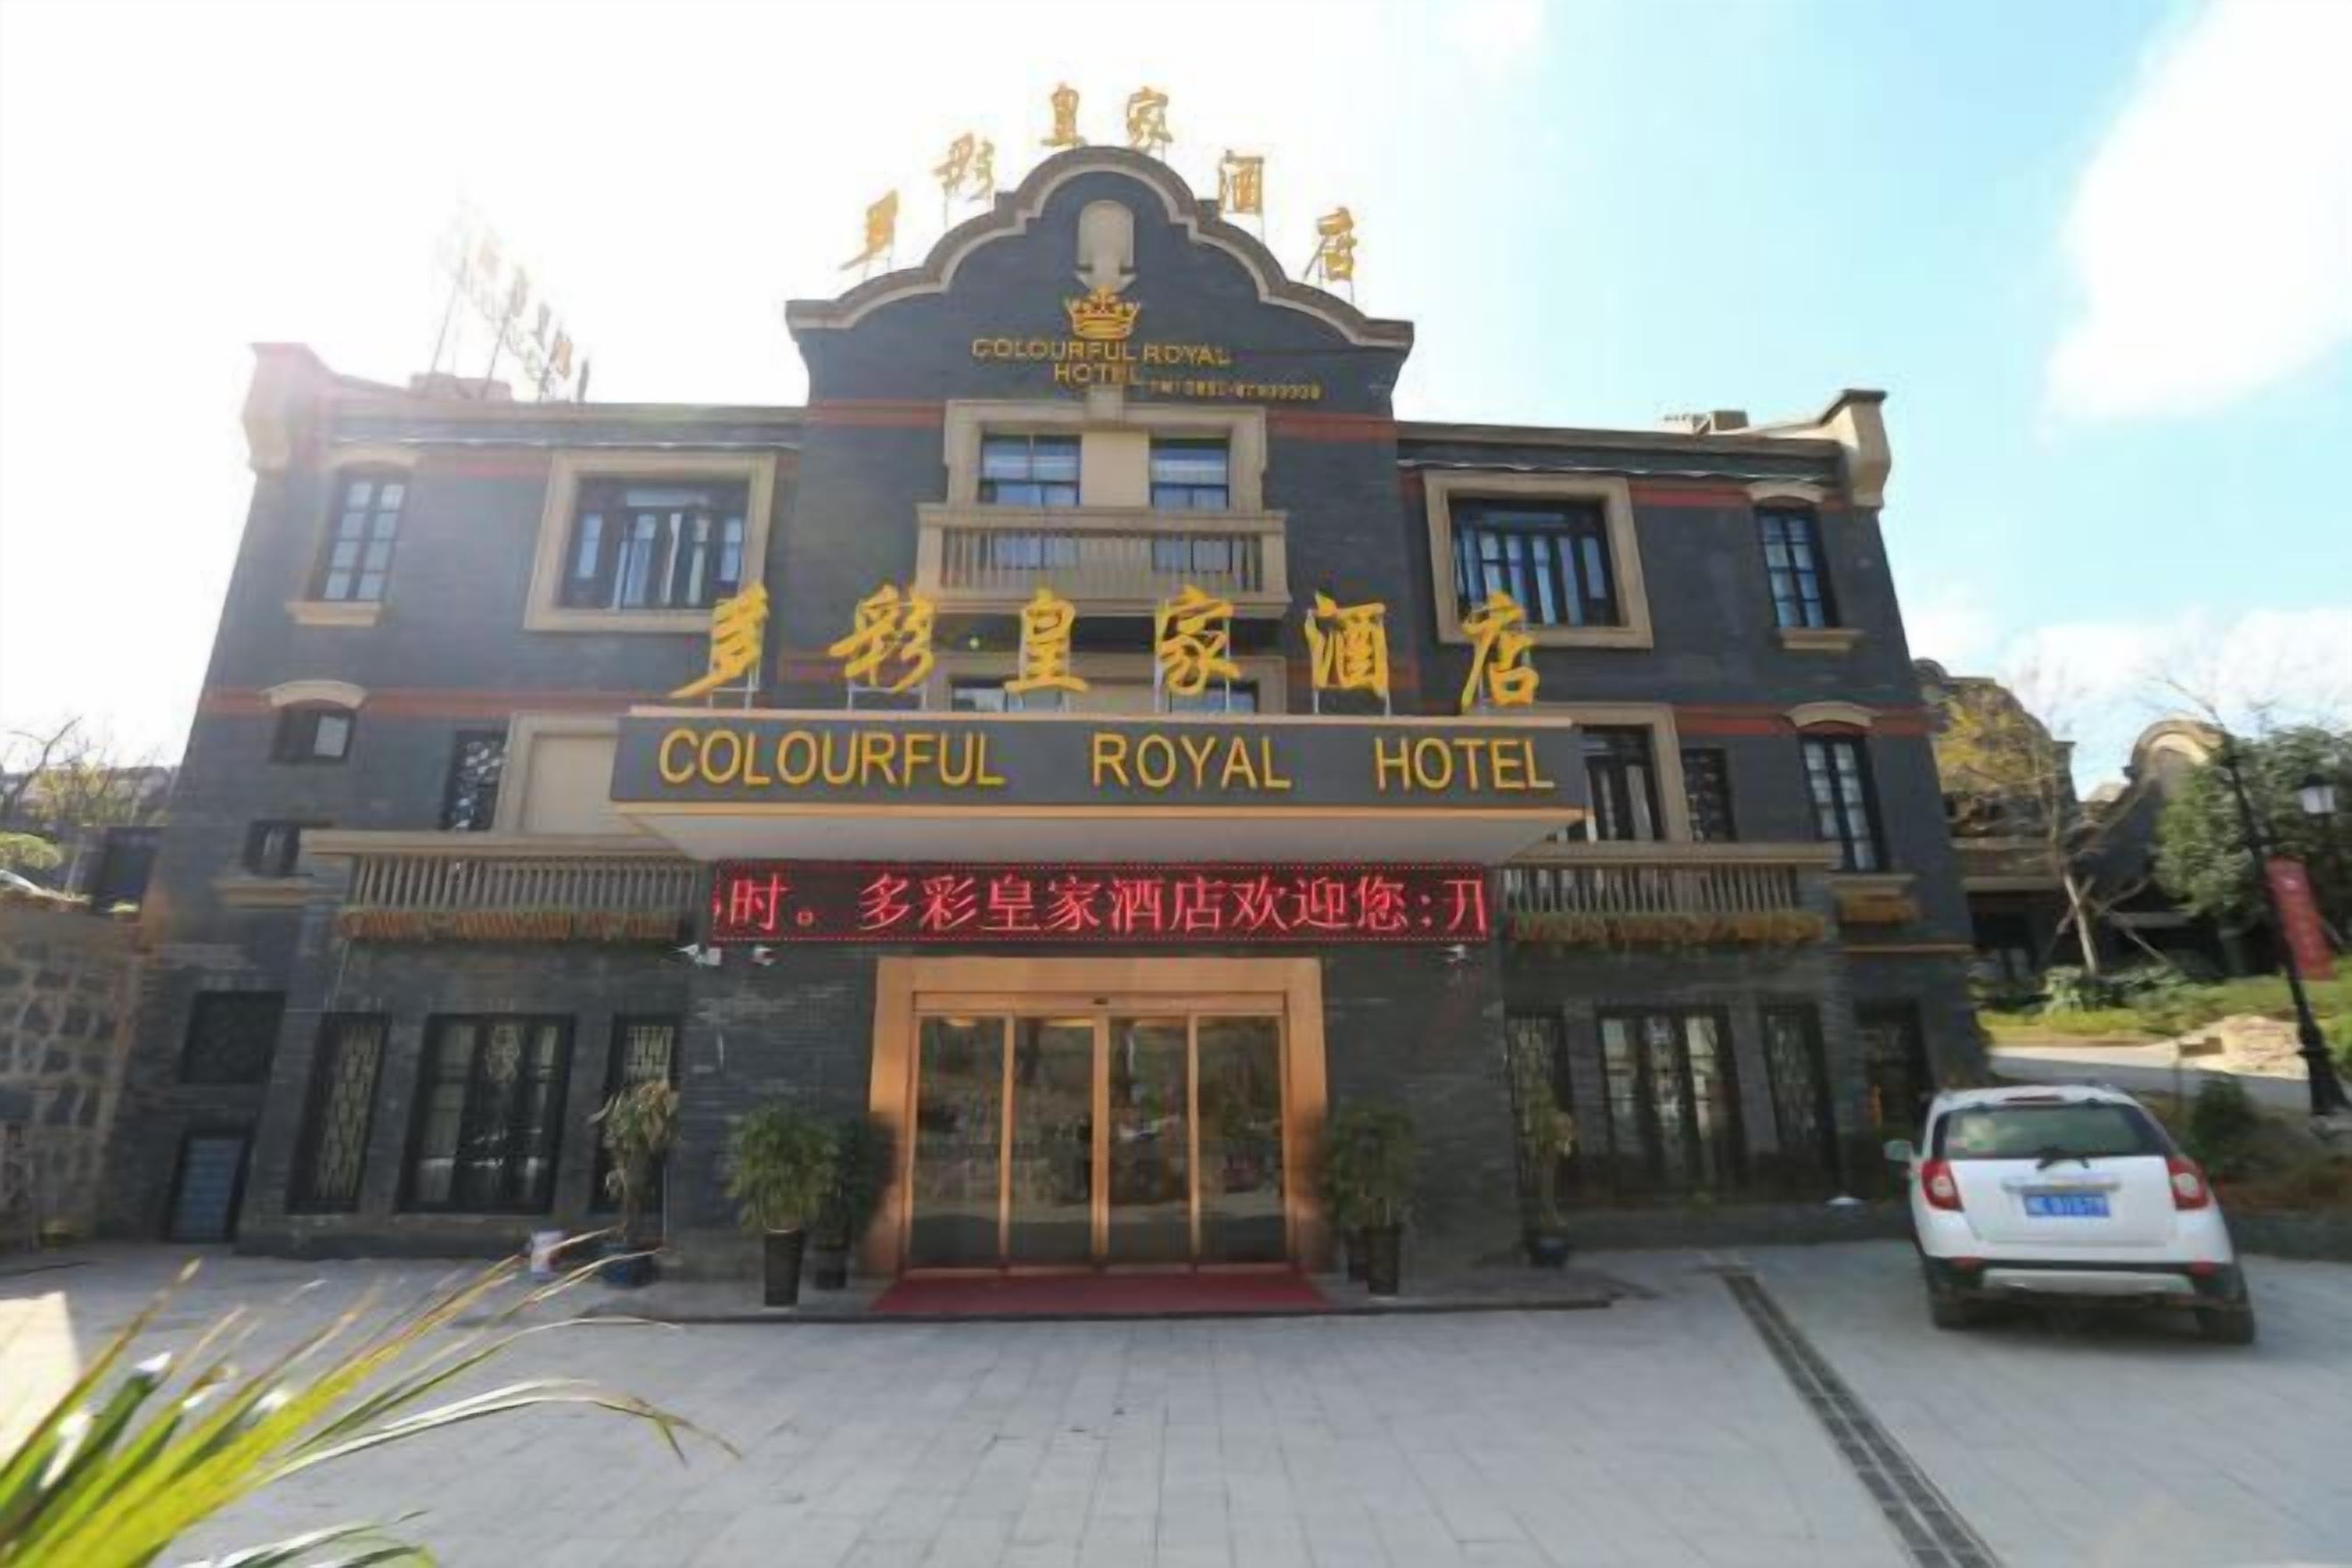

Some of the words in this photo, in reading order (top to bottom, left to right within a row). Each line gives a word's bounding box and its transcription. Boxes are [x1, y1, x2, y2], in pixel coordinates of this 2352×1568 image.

[972, 339, 1138, 361] COLOURFUL
[1142, 342, 1231, 364] ROYAL
[1053, 363, 1142, 385] HOTEL
[667, 583, 1540, 713] 多彩皇家酒店
[657, 728, 1008, 789] COLOURFUL
[1090, 731, 1294, 791] ROYAL
[1375, 735, 1557, 792] HOTEL
